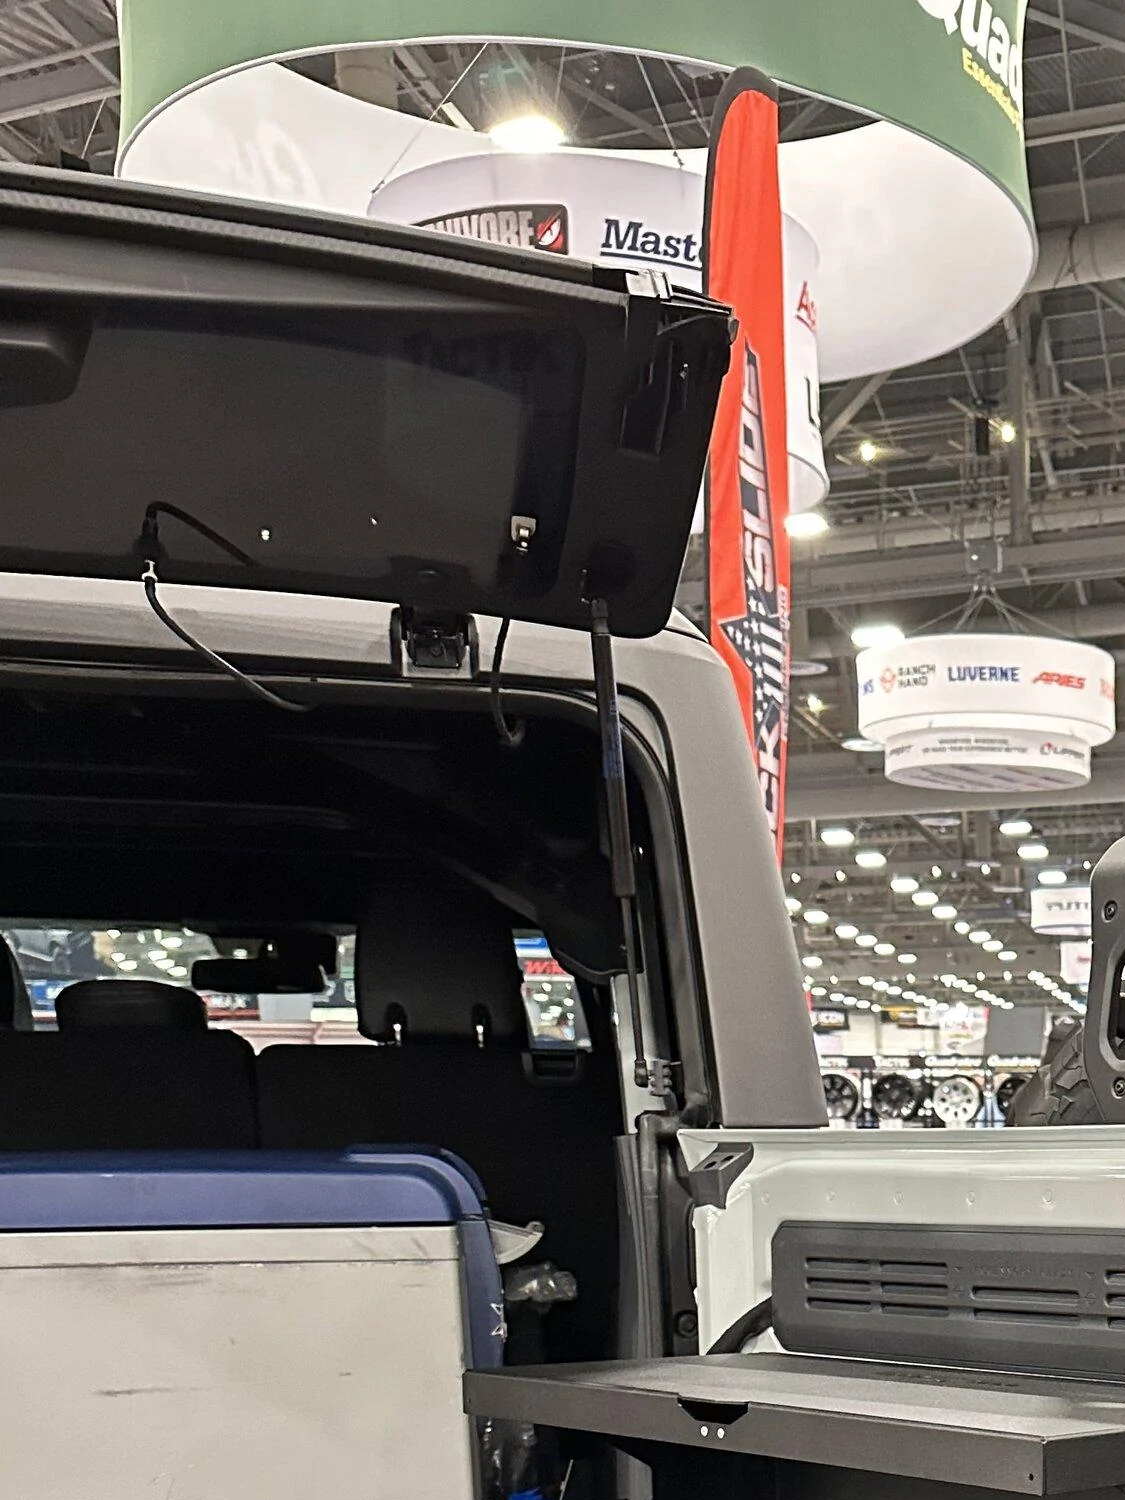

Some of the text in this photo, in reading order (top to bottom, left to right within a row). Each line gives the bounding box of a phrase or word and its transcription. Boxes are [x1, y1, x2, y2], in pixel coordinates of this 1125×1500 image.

[601, 218, 704, 263] Mast
[948, 666, 1020, 682] LUVERNE
[1032, 671, 1086, 690] ARIES
